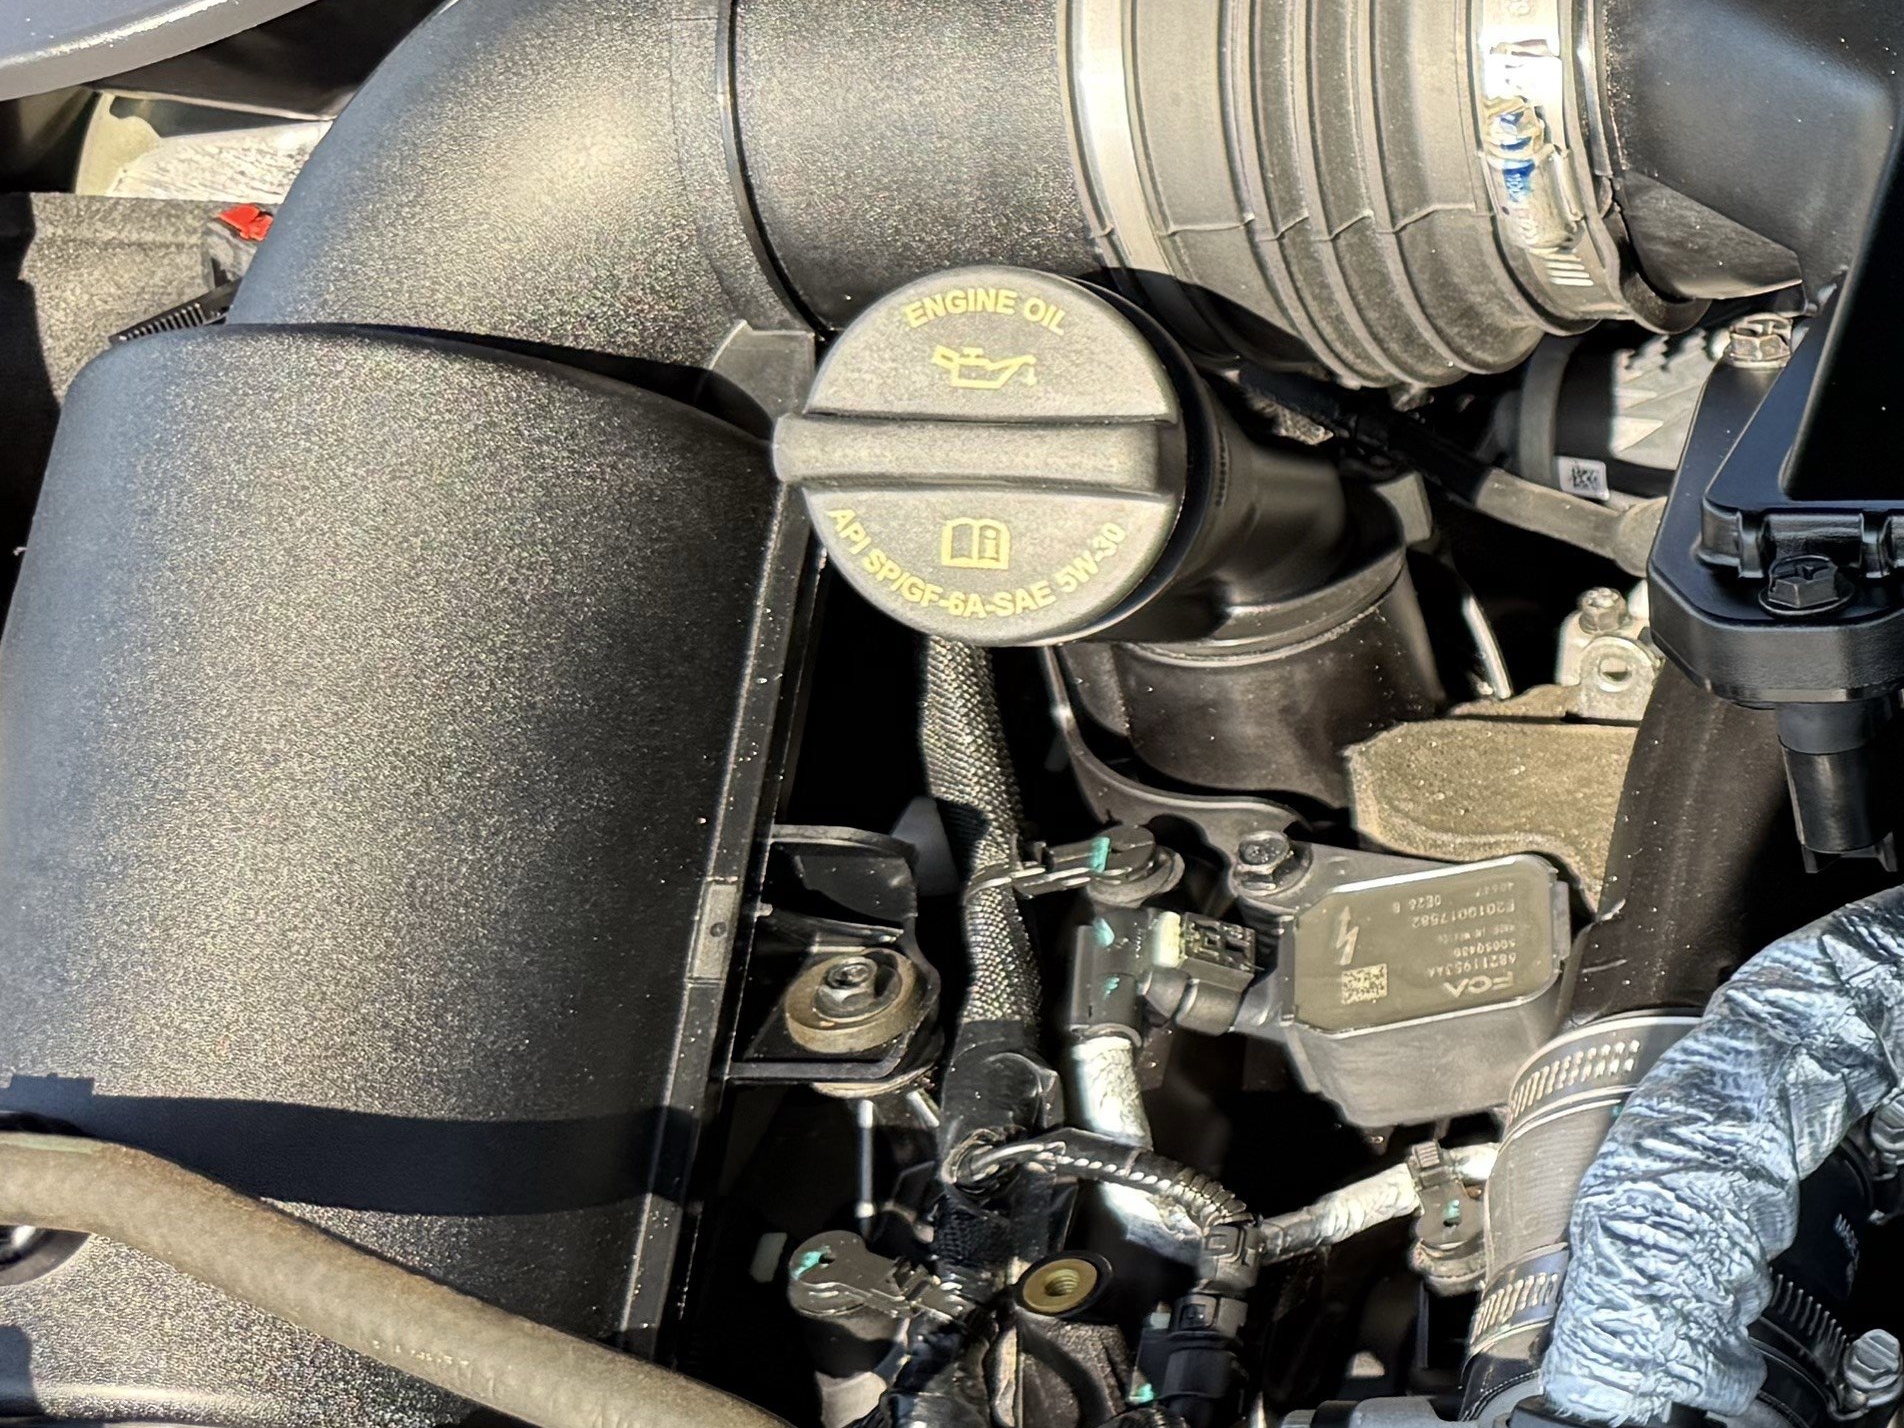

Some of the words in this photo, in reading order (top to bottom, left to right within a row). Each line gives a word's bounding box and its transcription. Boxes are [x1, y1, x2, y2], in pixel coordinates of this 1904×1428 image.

[905, 287, 1019, 329] ENGINE
[1023, 296, 1067, 336] OIL
[827, 507, 872, 556] API
[1060, 521, 1127, 594] 5W-30
[1442, 971, 1514, 997] FCA
